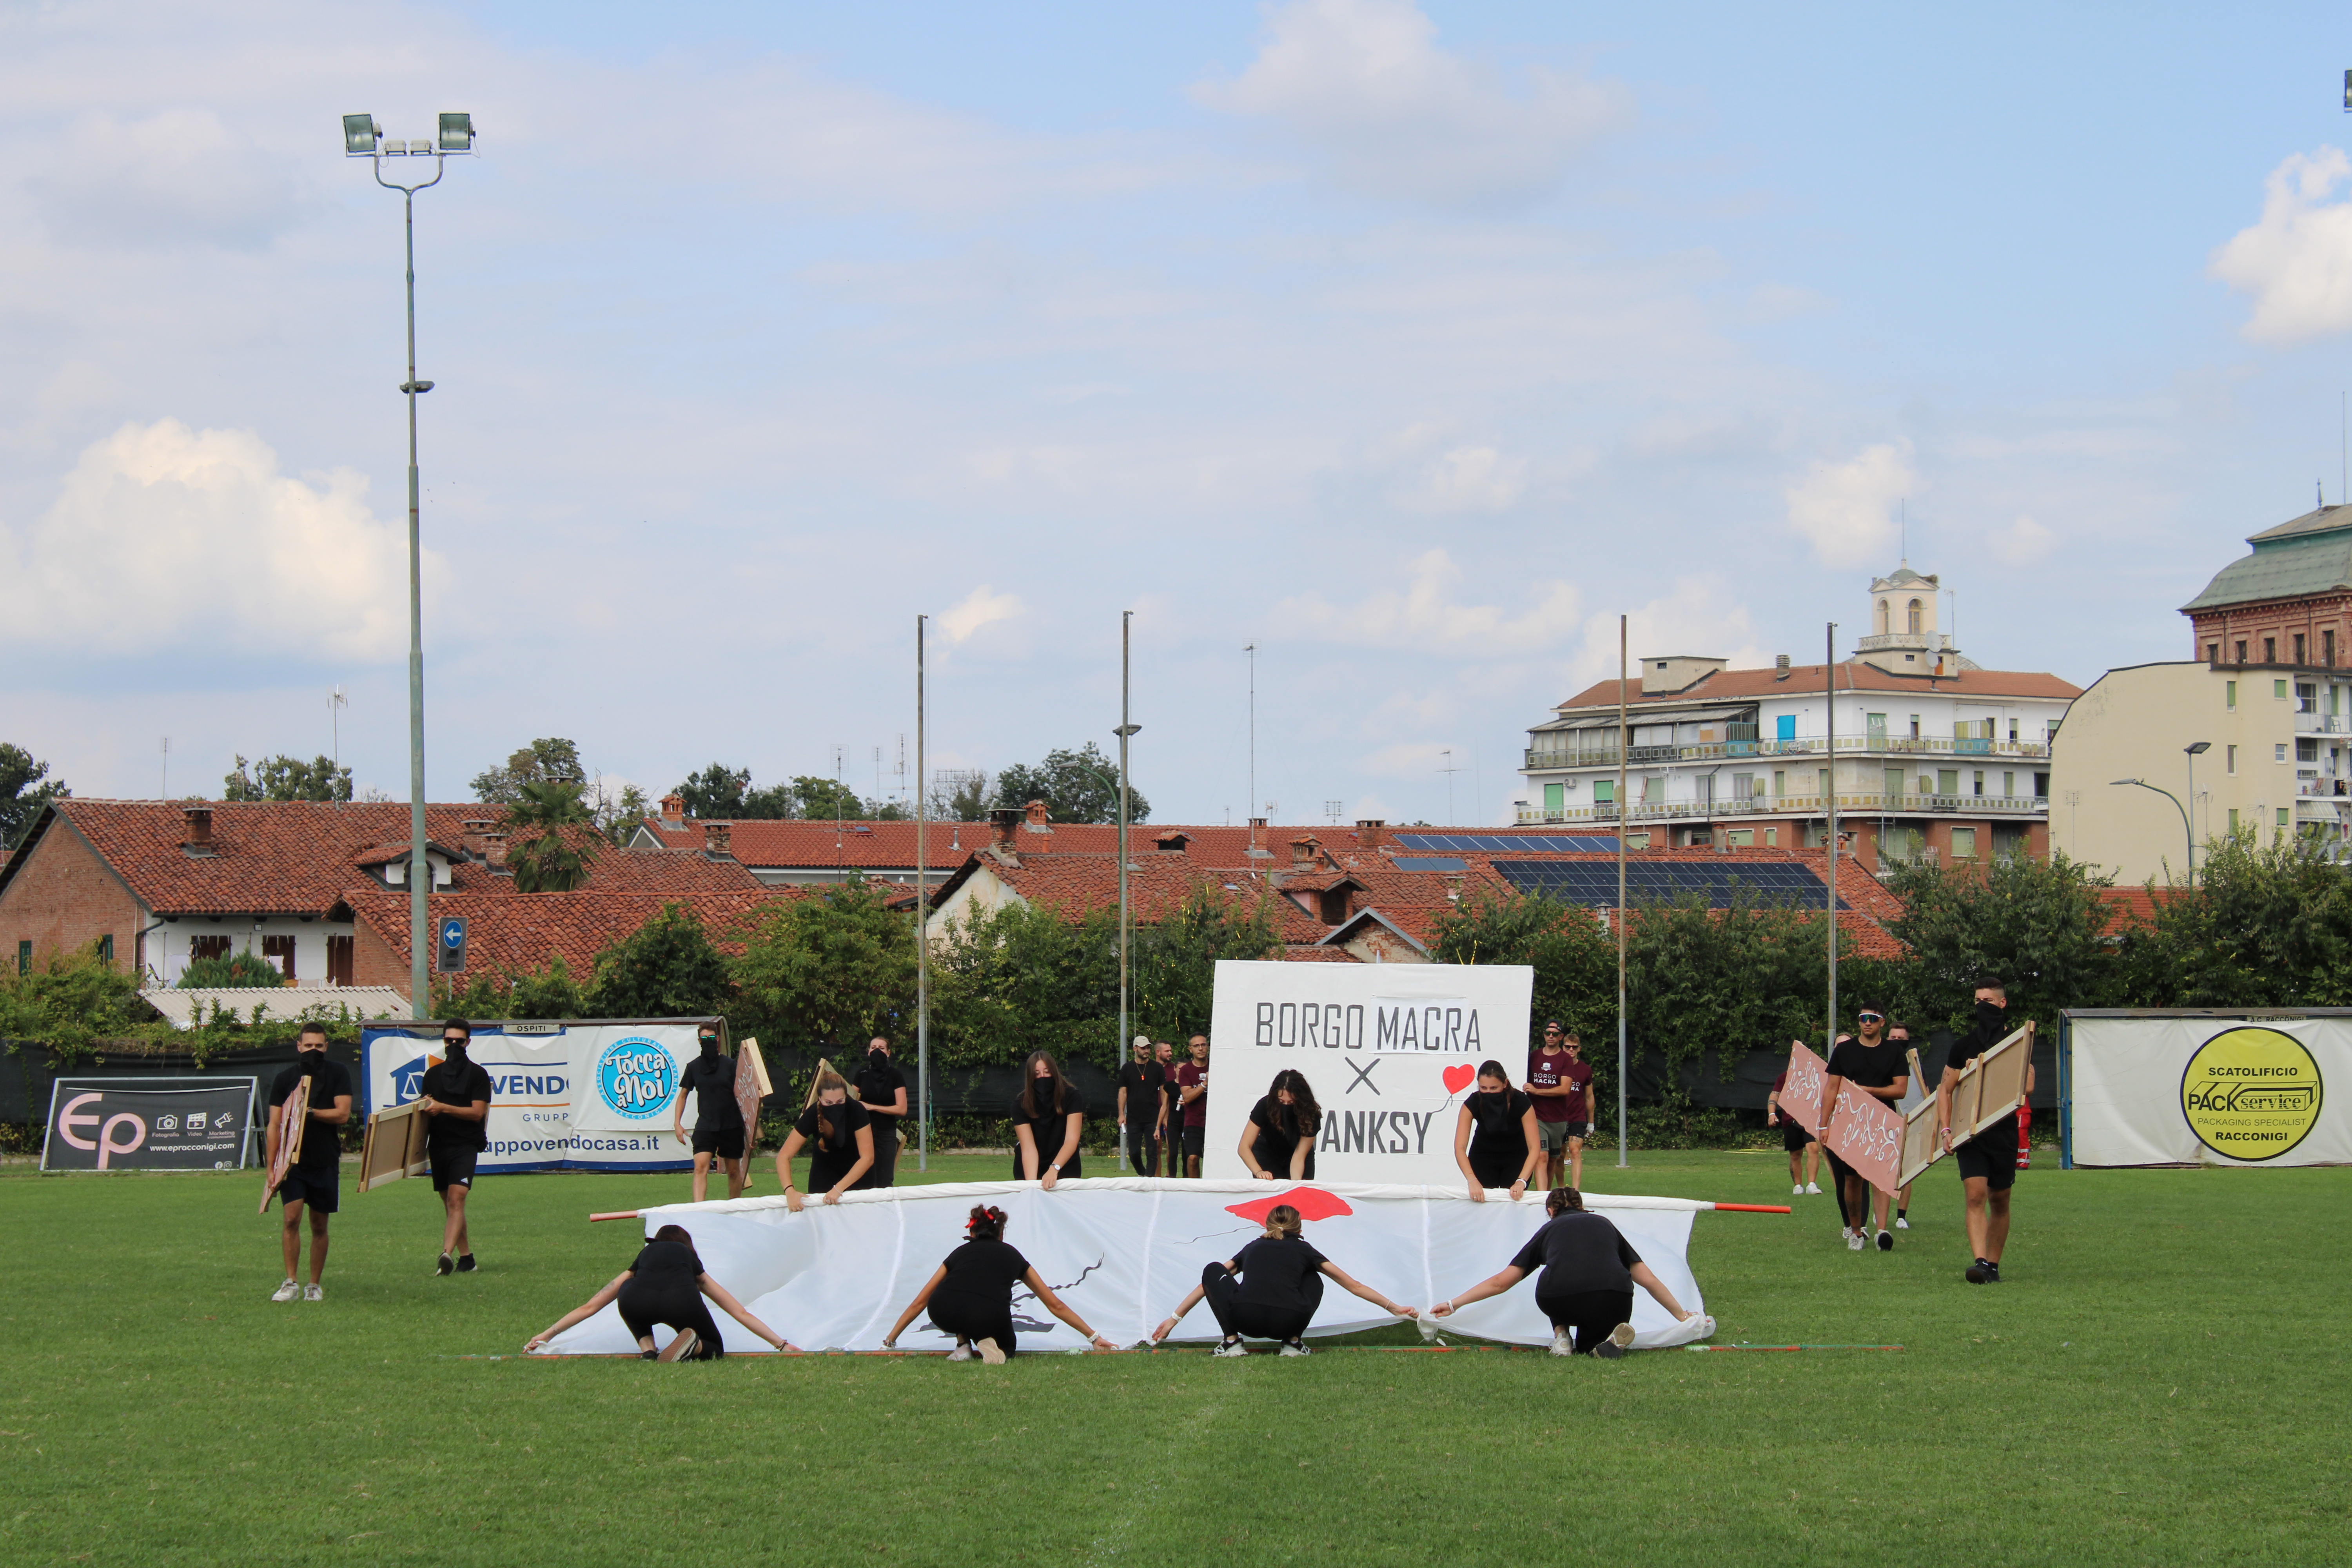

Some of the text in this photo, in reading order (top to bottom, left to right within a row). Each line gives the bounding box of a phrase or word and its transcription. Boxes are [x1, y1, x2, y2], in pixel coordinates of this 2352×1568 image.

[1256, 1002, 1481, 1052] BORGO MACRA
[597, 1037, 678, 1096] ASSOCIAZIONE CULTURALE GIOVANILE
[605, 1051, 667, 1075] Tocca
[2208, 1067, 2298, 1076] SCATOLIFICIO
[489, 1075, 570, 1095] VEND
[613, 1070, 667, 1108] a Noi
[613, 1106, 664, 1119] RACCONIGI
[2254, 1118, 2307, 1126] SPECIALIST
[1314, 1110, 1433, 1154] ANKSY
[2216, 1132, 2288, 1141] RACCONIGI
[149, 1143, 234, 1153] www.epracconigi.com
